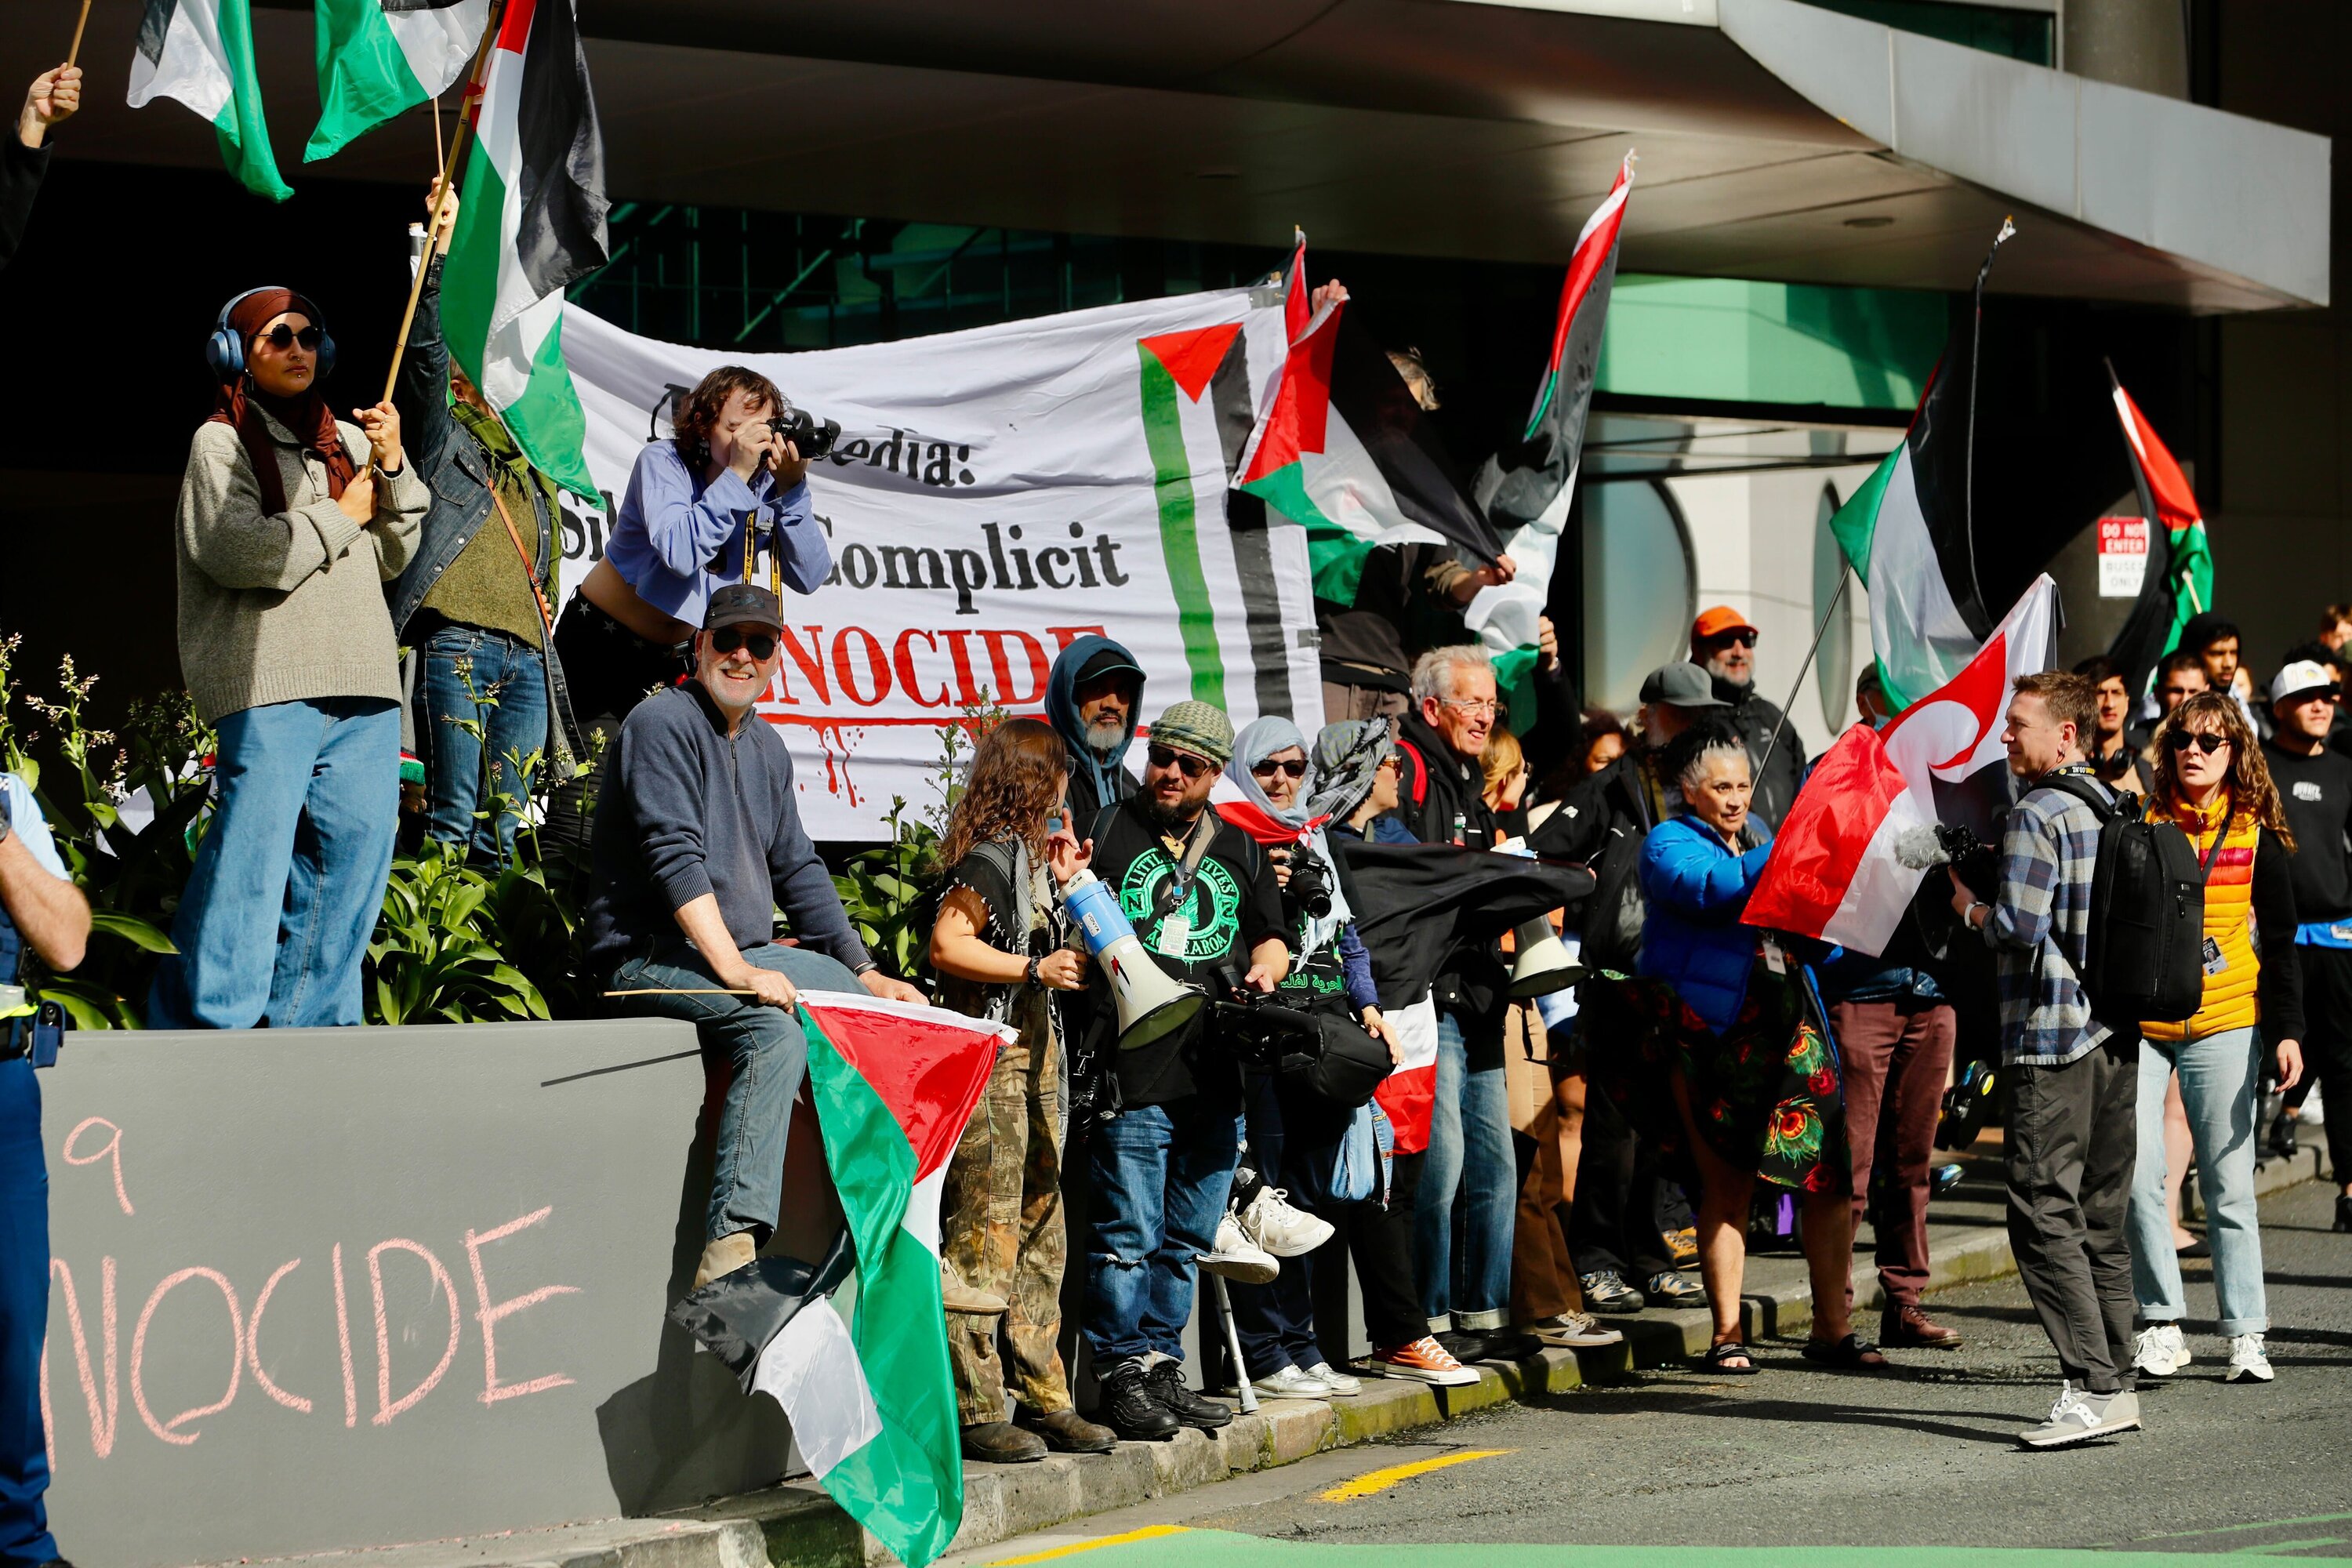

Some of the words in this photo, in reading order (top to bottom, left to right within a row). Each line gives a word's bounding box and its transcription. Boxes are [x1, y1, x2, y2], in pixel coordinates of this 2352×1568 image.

[829, 424, 975, 488] edia:
[2102, 523, 2120, 539] DO
[2105, 539, 2144, 554] ENTER
[815, 522, 1129, 615] omplicit
[2110, 577, 2140, 587] ONLY
[753, 625, 1109, 708] NOCID
[1200, 858, 1236, 894] TIVES
[1145, 929, 1228, 955] AEAROA
[39, 1205, 582, 1474] NOCIDE
